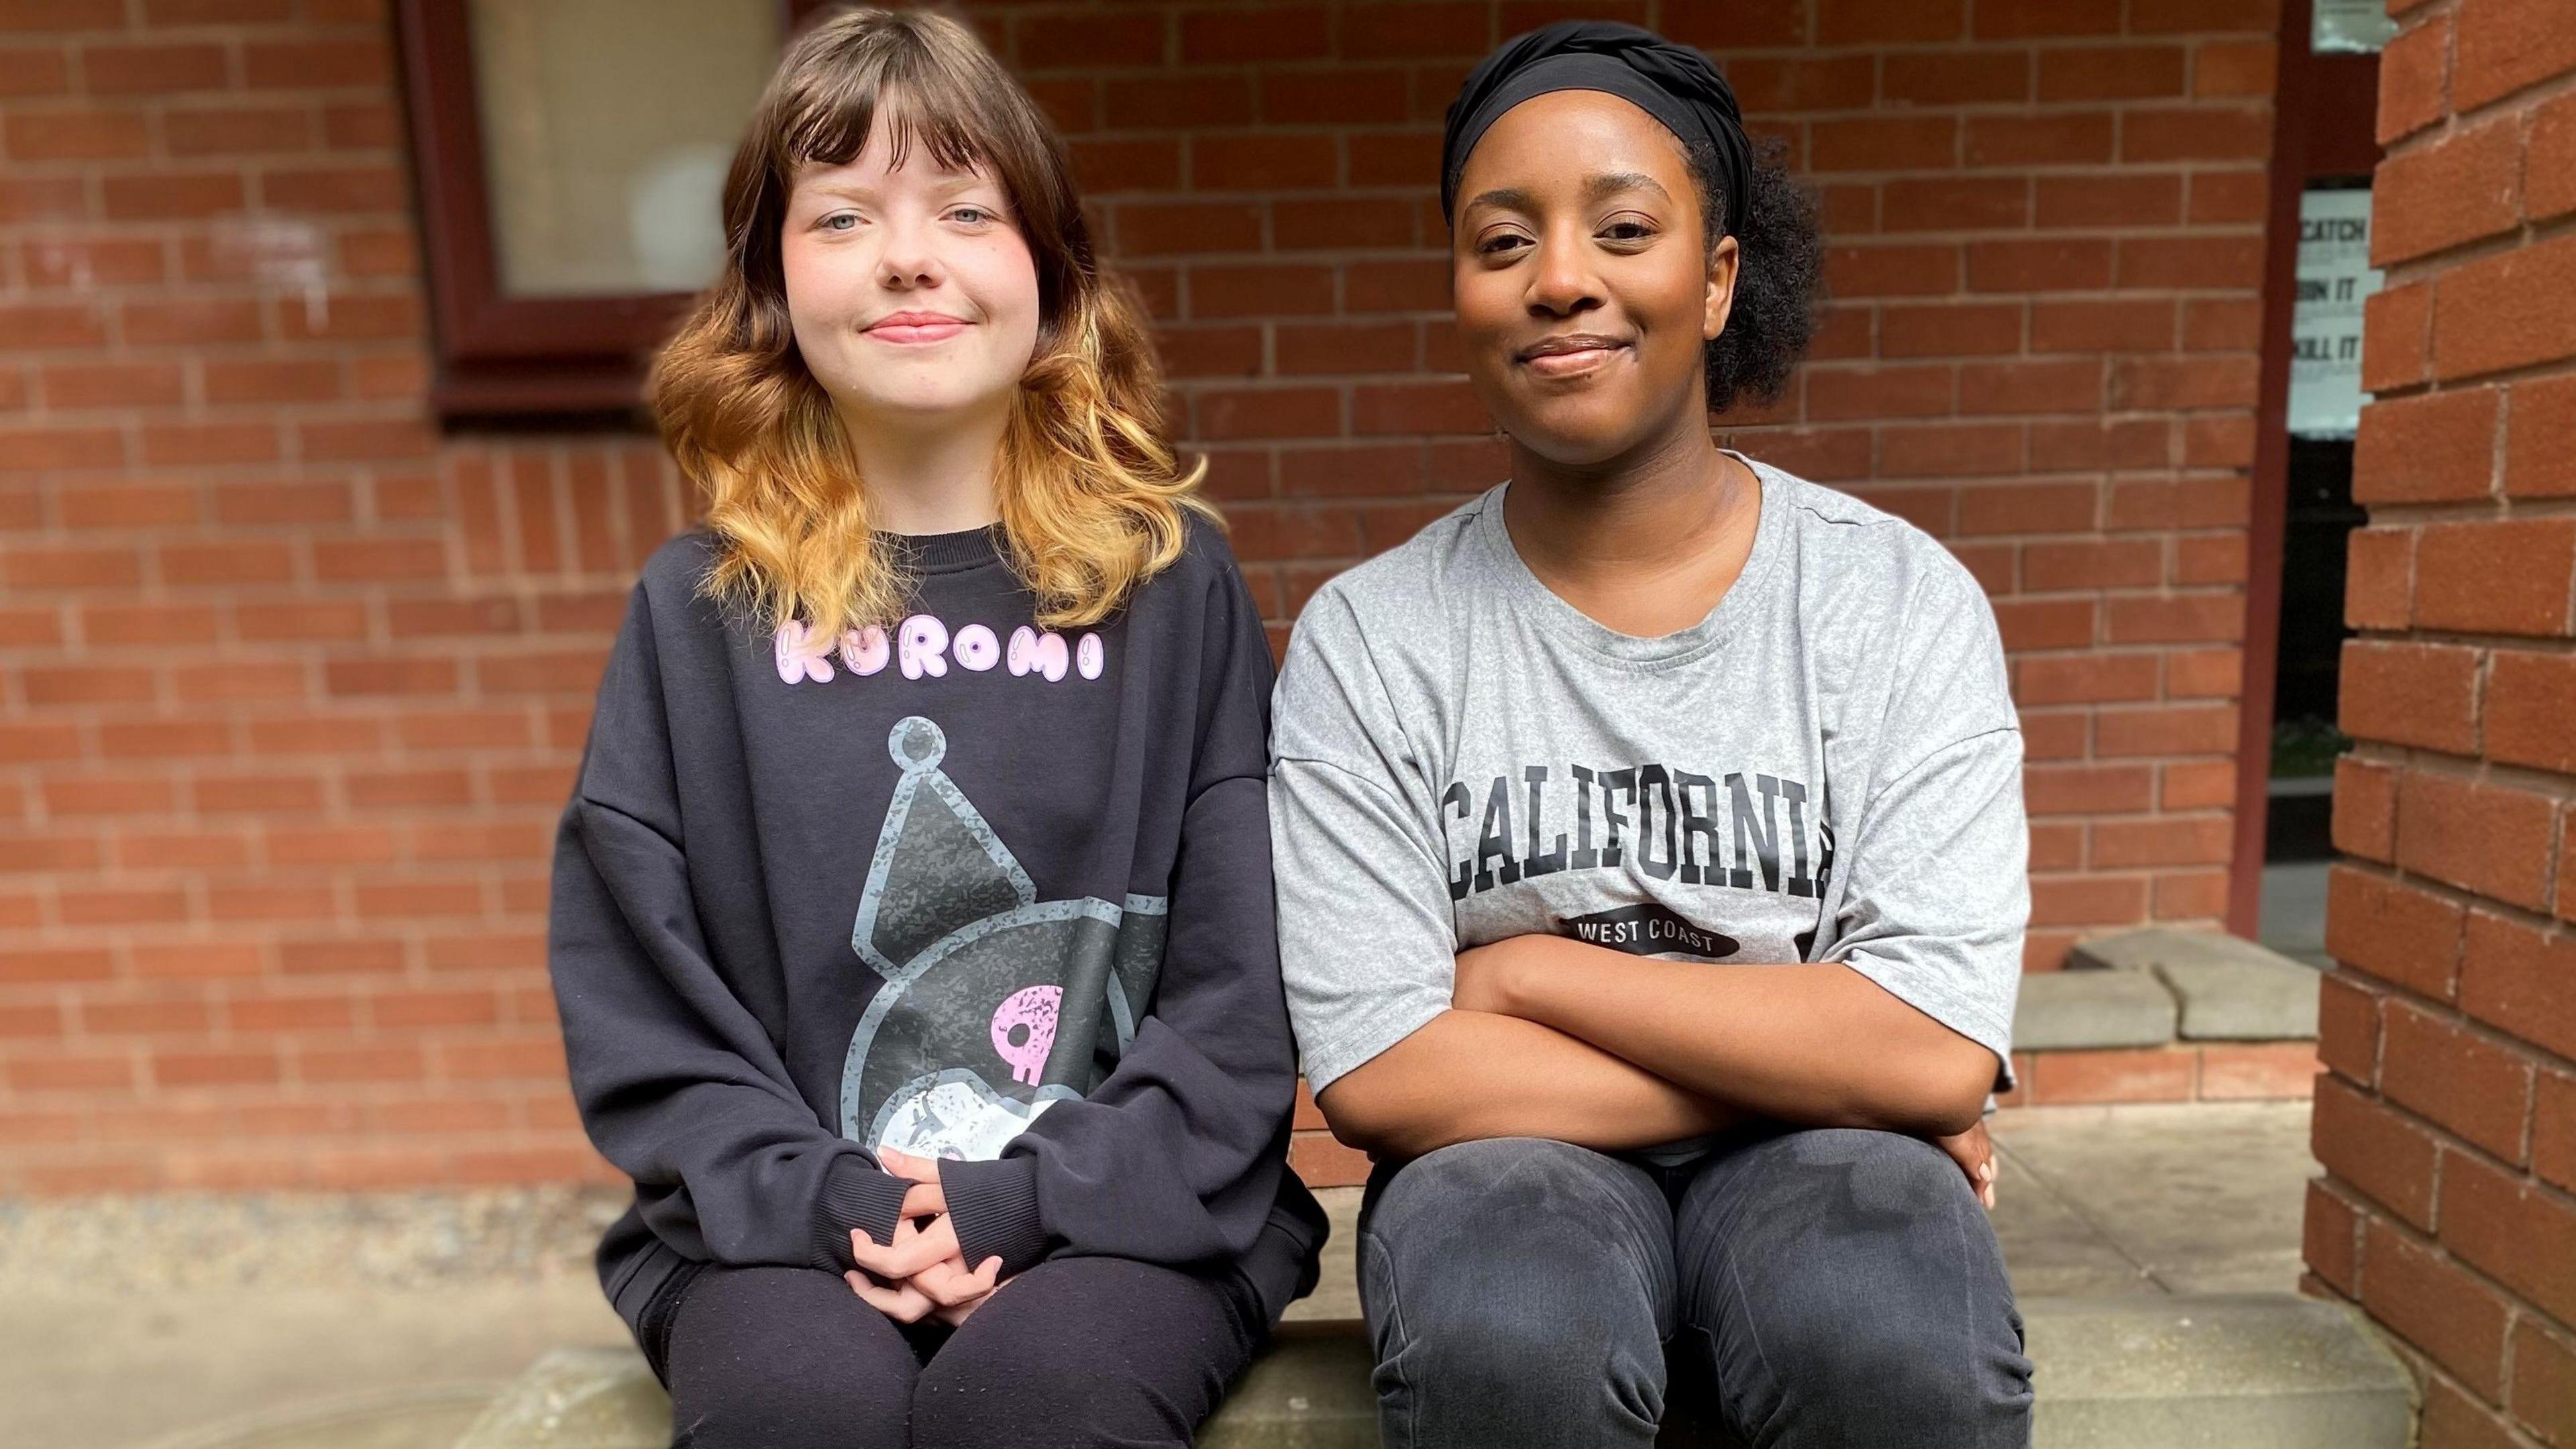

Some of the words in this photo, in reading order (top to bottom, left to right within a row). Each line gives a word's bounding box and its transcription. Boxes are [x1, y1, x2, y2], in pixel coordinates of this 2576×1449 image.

[2337, 276, 2357, 301] IT
[2340, 335, 2359, 360] IT
[775, 613, 1104, 685] KUROMI
[1577, 920, 1639, 943] WEST
[1649, 918, 1713, 951] COAST
